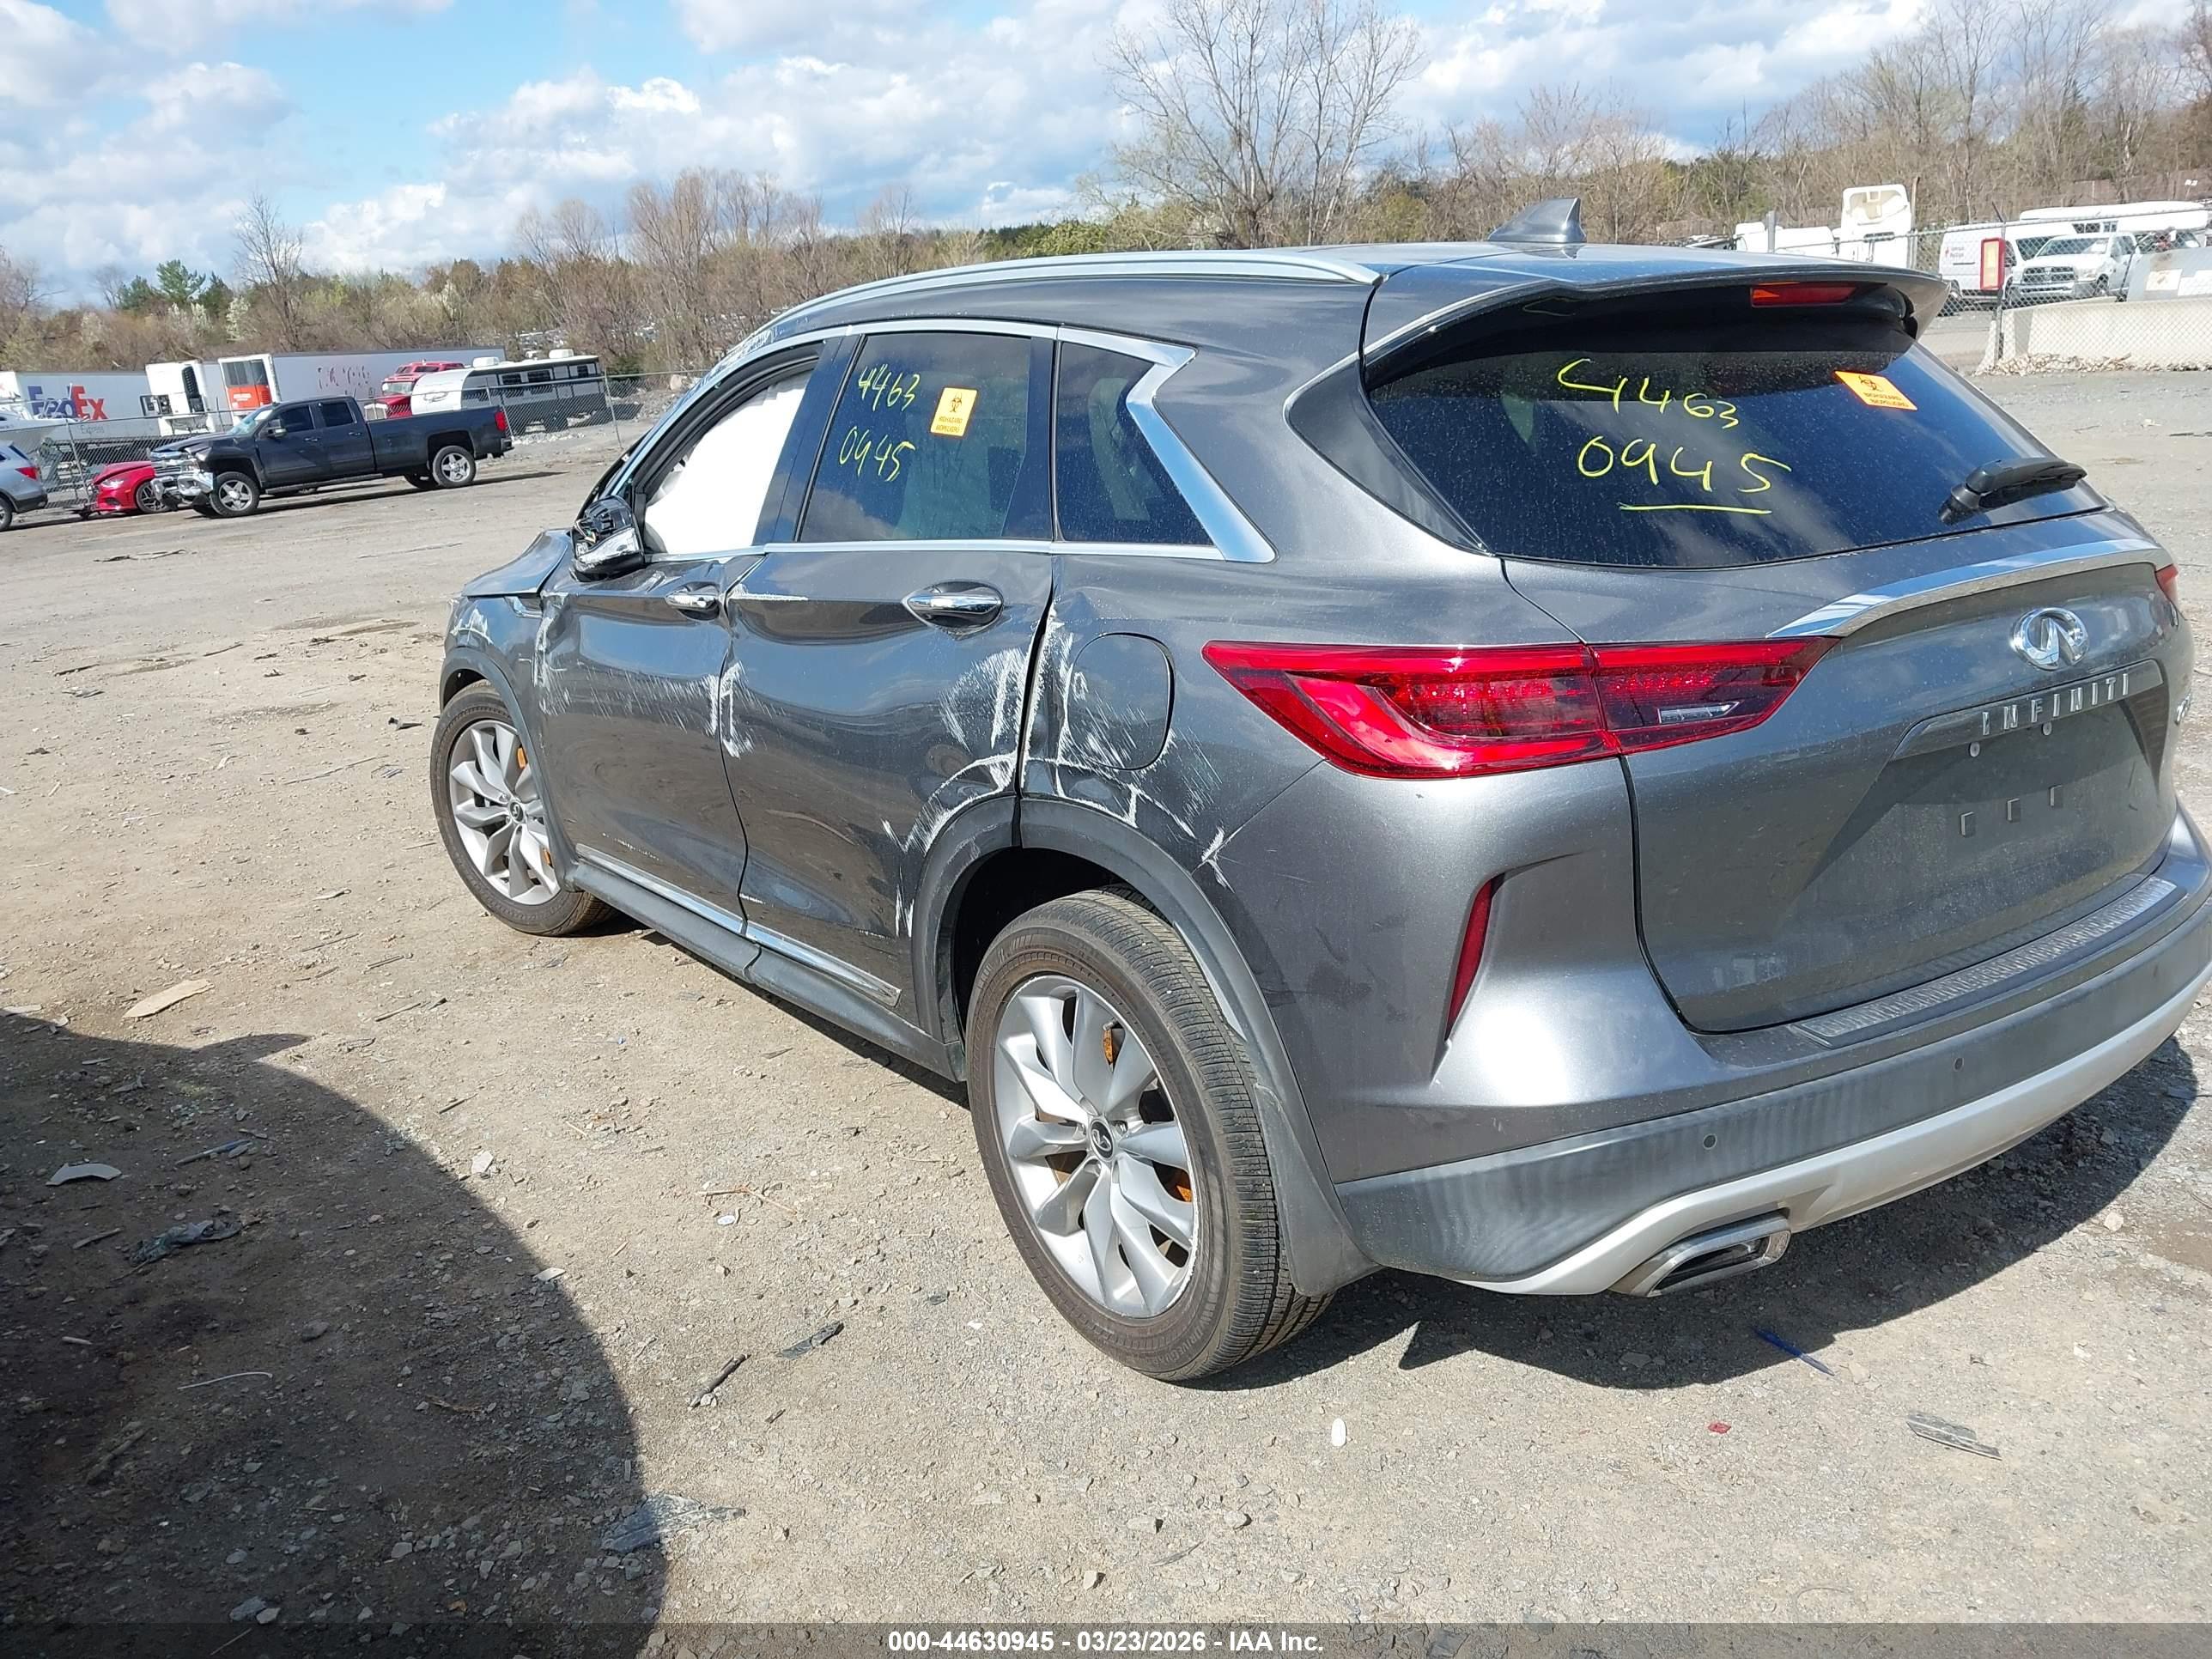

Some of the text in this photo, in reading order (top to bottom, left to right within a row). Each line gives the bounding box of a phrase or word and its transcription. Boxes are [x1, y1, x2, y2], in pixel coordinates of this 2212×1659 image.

[27, 385, 109, 421] FedEx
[858, 363, 921, 412] 4463
[1555, 357, 1739, 429] 4463
[839, 425, 916, 483] 0945
[1577, 434, 1792, 493] 0945
[1982, 673, 2129, 736] INFINITI
